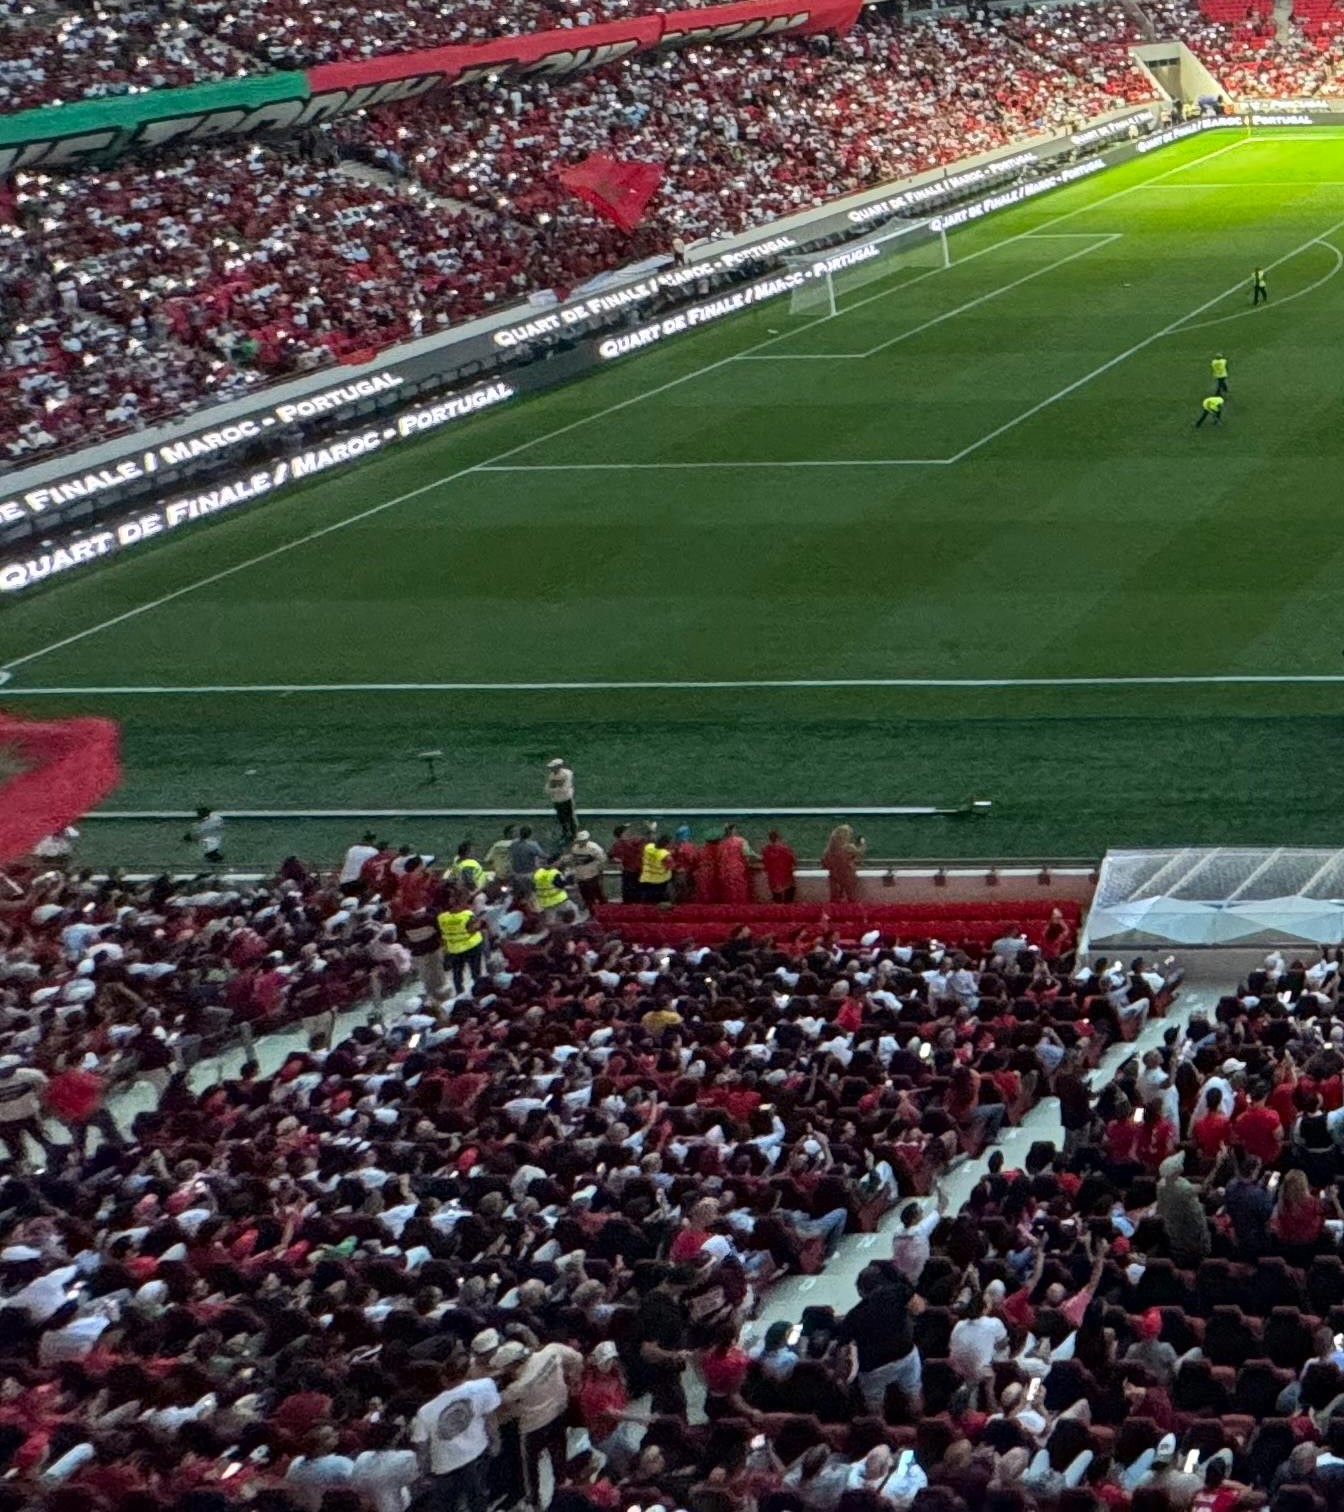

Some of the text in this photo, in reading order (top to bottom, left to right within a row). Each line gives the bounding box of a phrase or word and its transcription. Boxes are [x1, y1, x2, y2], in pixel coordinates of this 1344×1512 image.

[600, 324, 660, 357] QUART
[662, 311, 687, 334] DE
[687, 293, 743, 324] FINALE
[0, 532, 113, 590] QUART
[117, 514, 162, 544] DE
[166, 472, 271, 526] FINALE
[291, 432, 380, 477] MAROC
[398, 383, 513, 436] PORTUGAL
[26, 462, 142, 511] FINALE
[159, 421, 260, 464] MAROC
[275, 373, 403, 422] PORTUGAL
